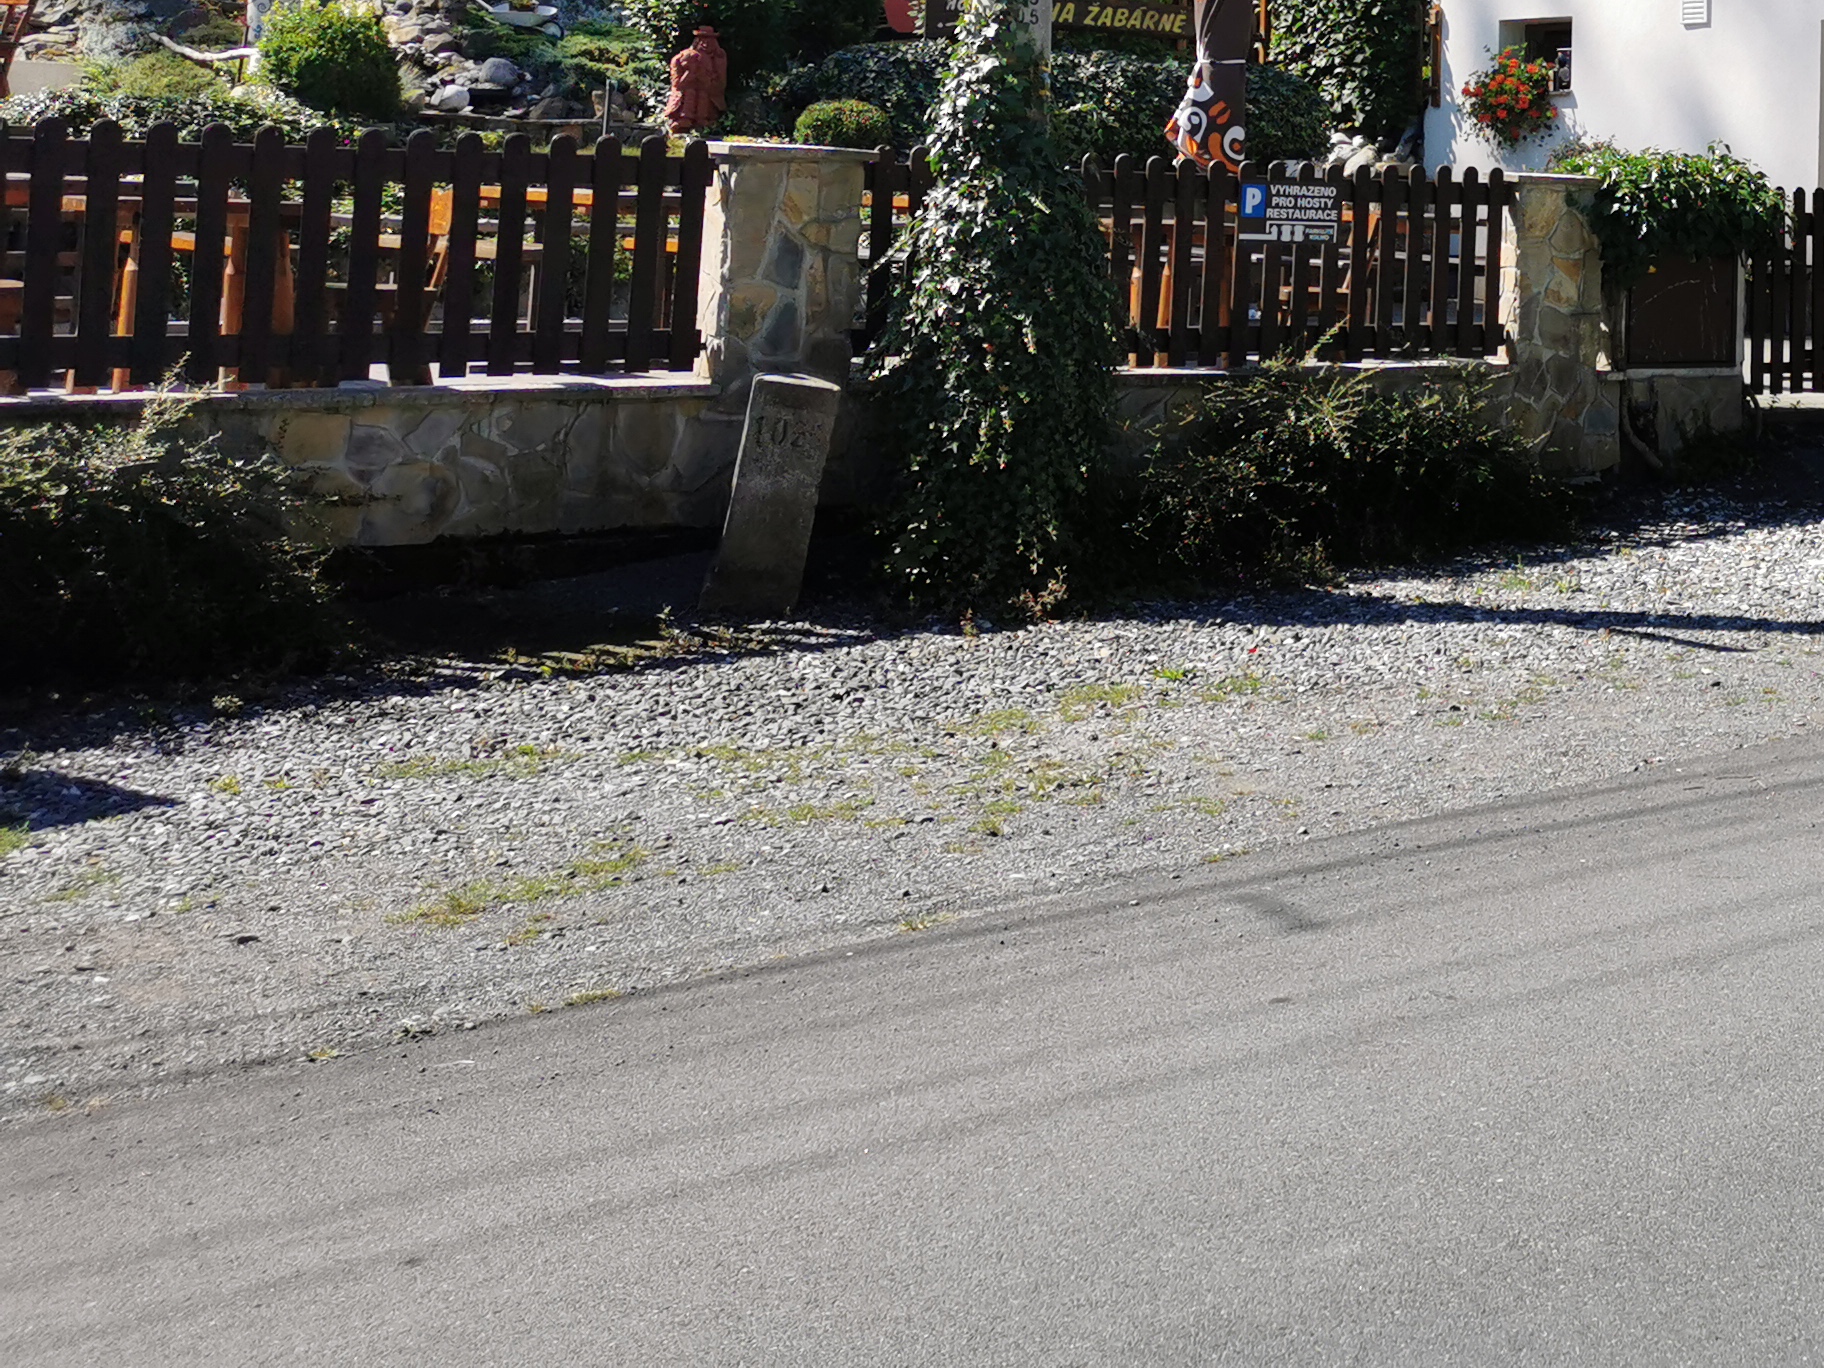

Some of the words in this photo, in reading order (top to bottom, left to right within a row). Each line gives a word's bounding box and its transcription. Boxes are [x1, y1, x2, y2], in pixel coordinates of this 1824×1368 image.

[1083, 1, 1188, 34] ŽABÁRNĚ
[1270, 185, 1337, 197] VYHRAZENO
[1245, 187, 1262, 214] P
[1272, 197, 1295, 207] PRO
[1297, 198, 1334, 208] HOSTY
[1266, 209, 1338, 220] RESTAURACE
